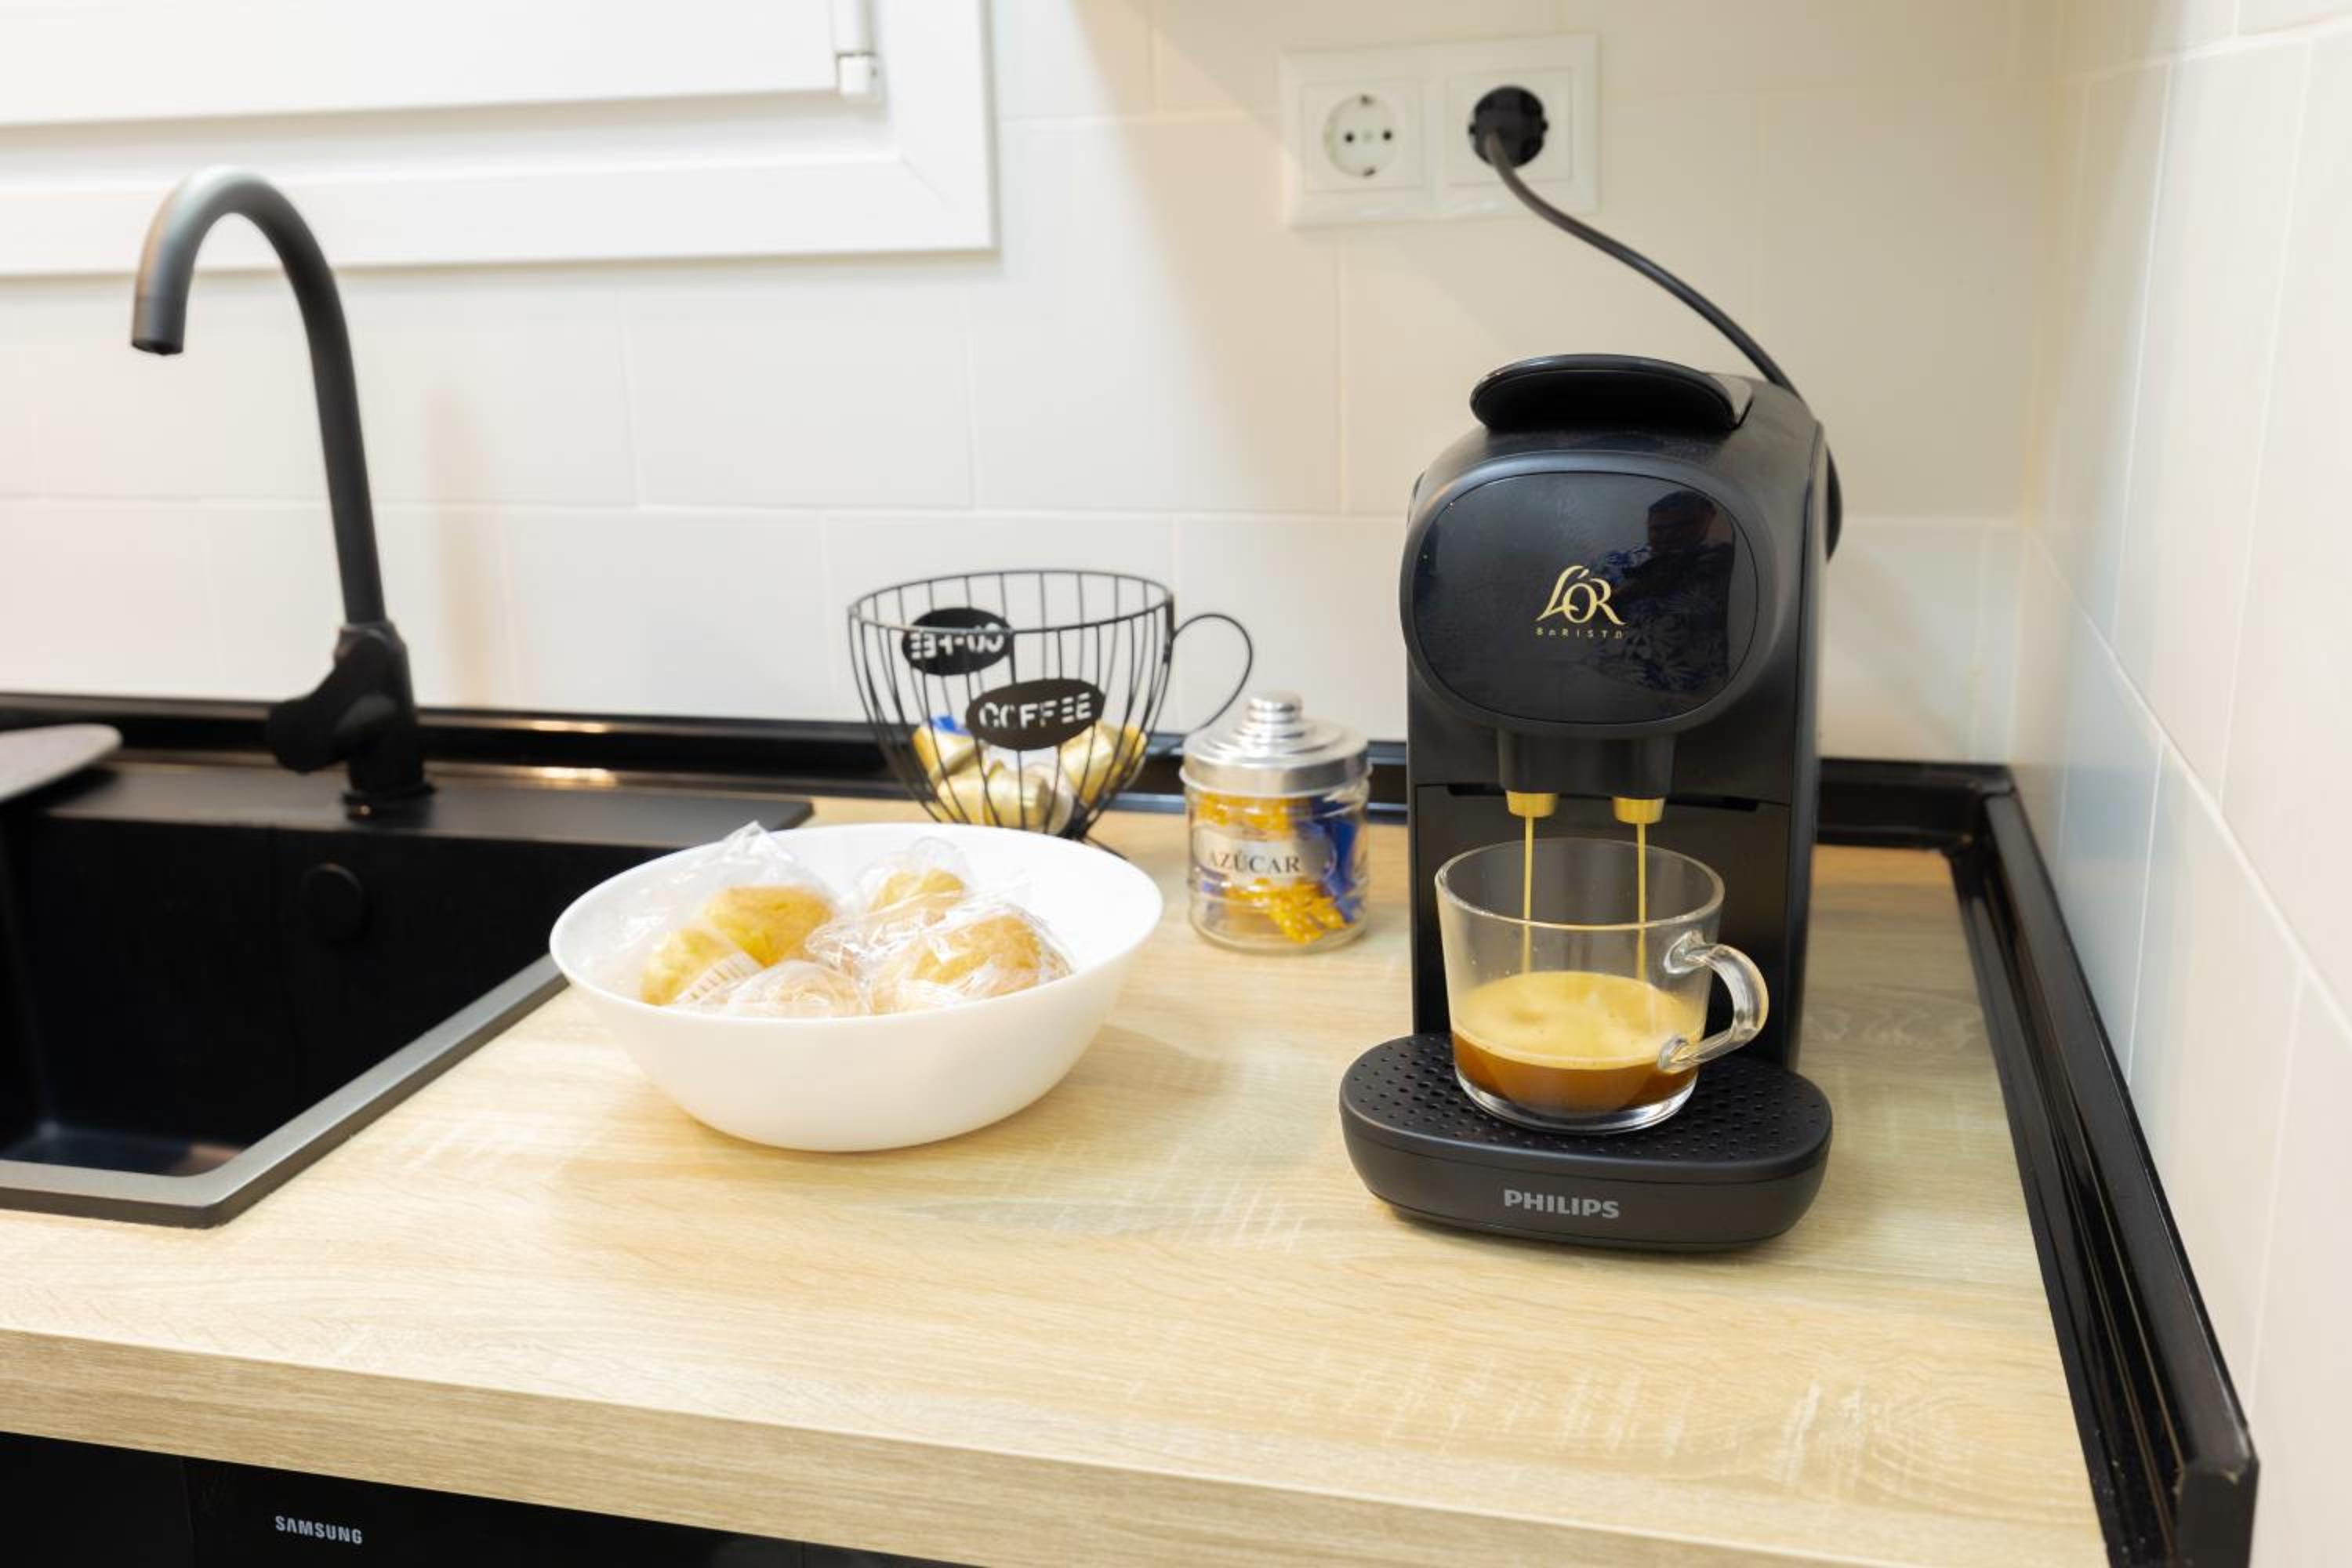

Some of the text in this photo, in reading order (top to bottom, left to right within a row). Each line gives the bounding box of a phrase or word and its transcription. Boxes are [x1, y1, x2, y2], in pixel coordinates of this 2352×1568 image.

[979, 692, 1092, 729] COFFEE
[1208, 848, 1301, 873] AZÚCAR
[1504, 1189, 1620, 1219] PHILIPS
[274, 1515, 363, 1544] SAMSUNG
